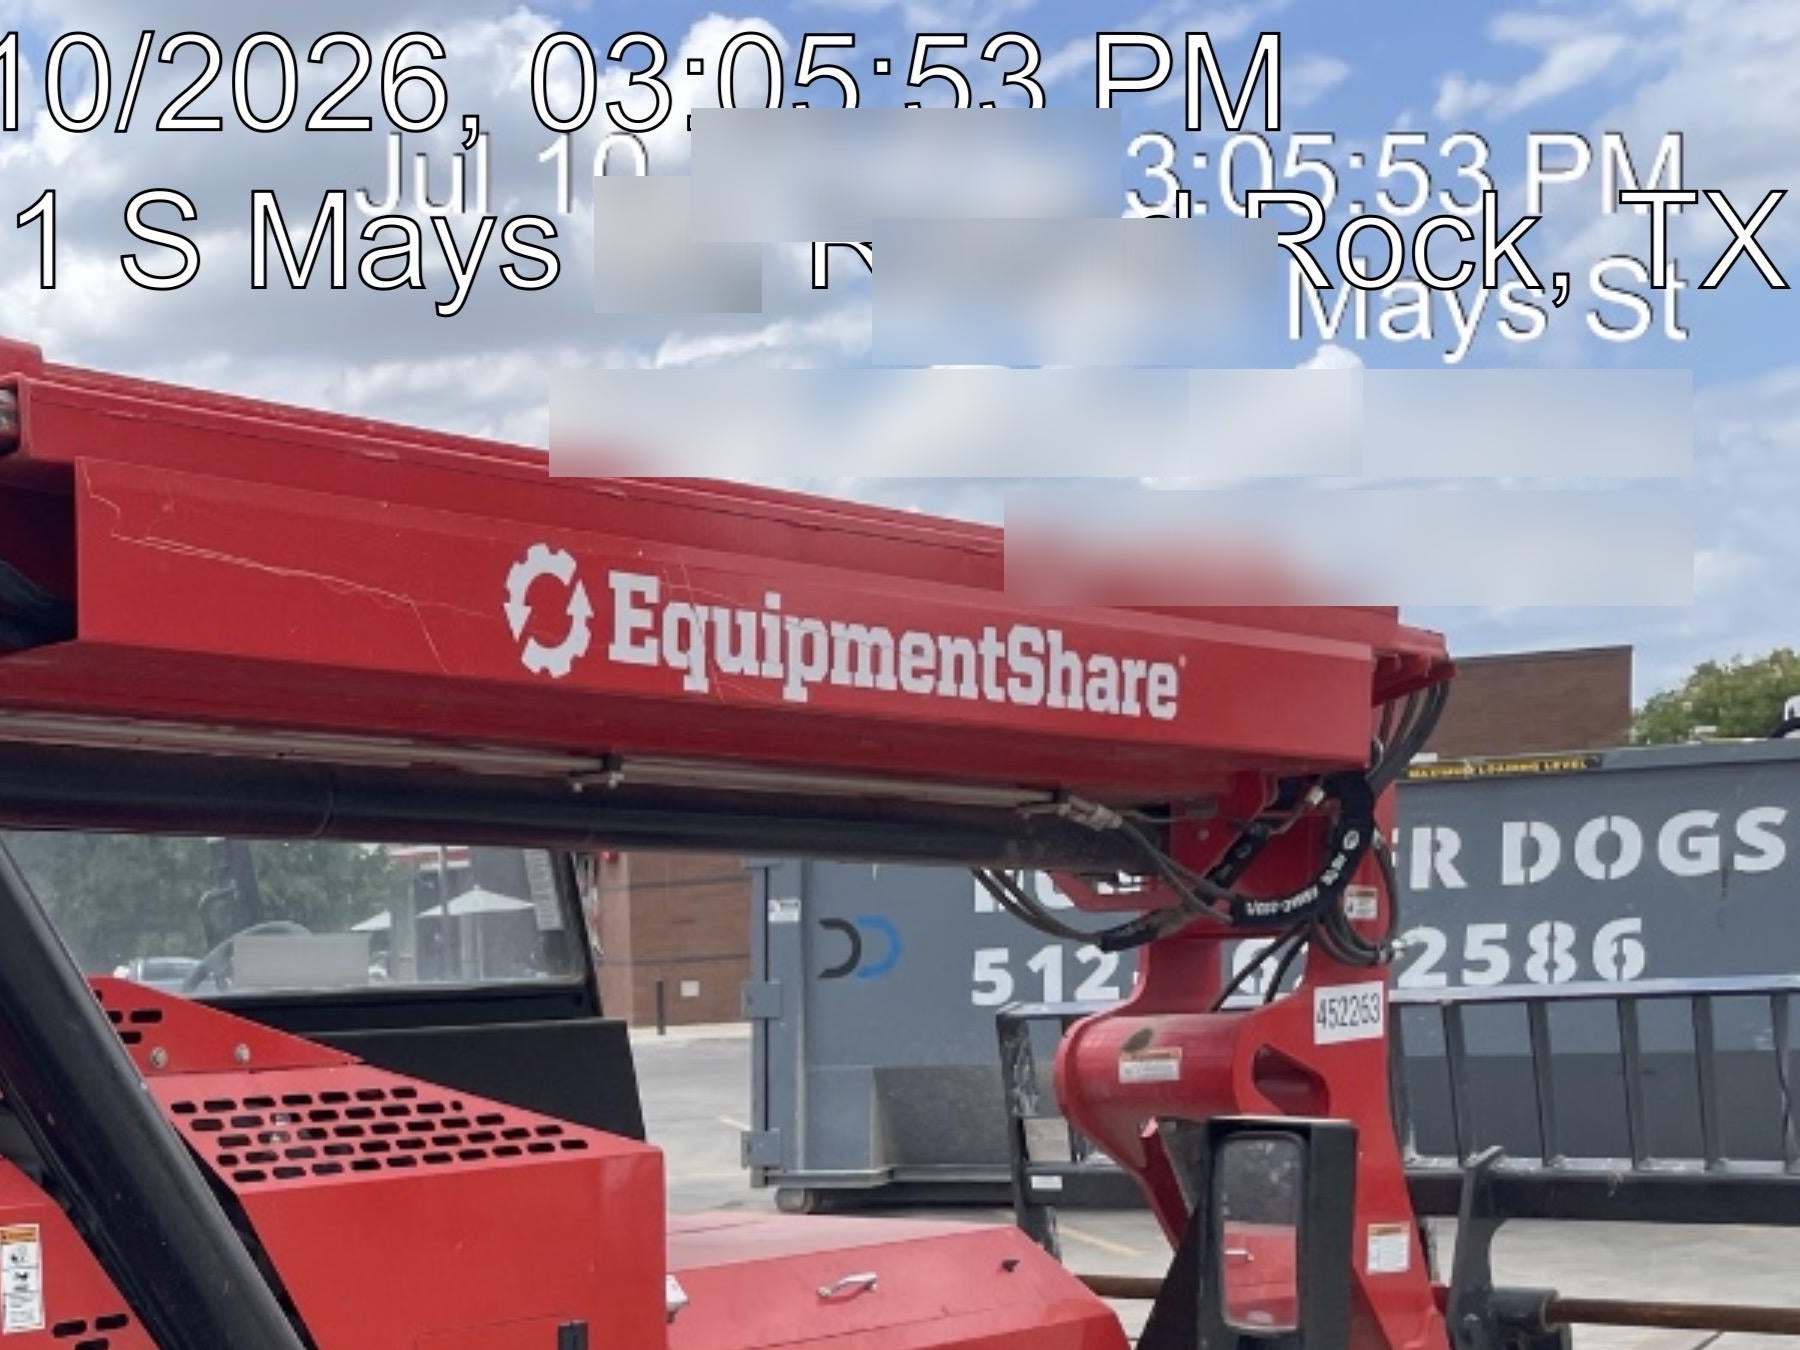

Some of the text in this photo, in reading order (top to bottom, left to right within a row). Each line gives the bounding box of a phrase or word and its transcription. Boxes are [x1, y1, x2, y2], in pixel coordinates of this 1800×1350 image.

[607, 570, 1181, 721] EquipmentShare
[1501, 805, 1790, 887] DOGS
[1315, 991, 1381, 1030] 452263
